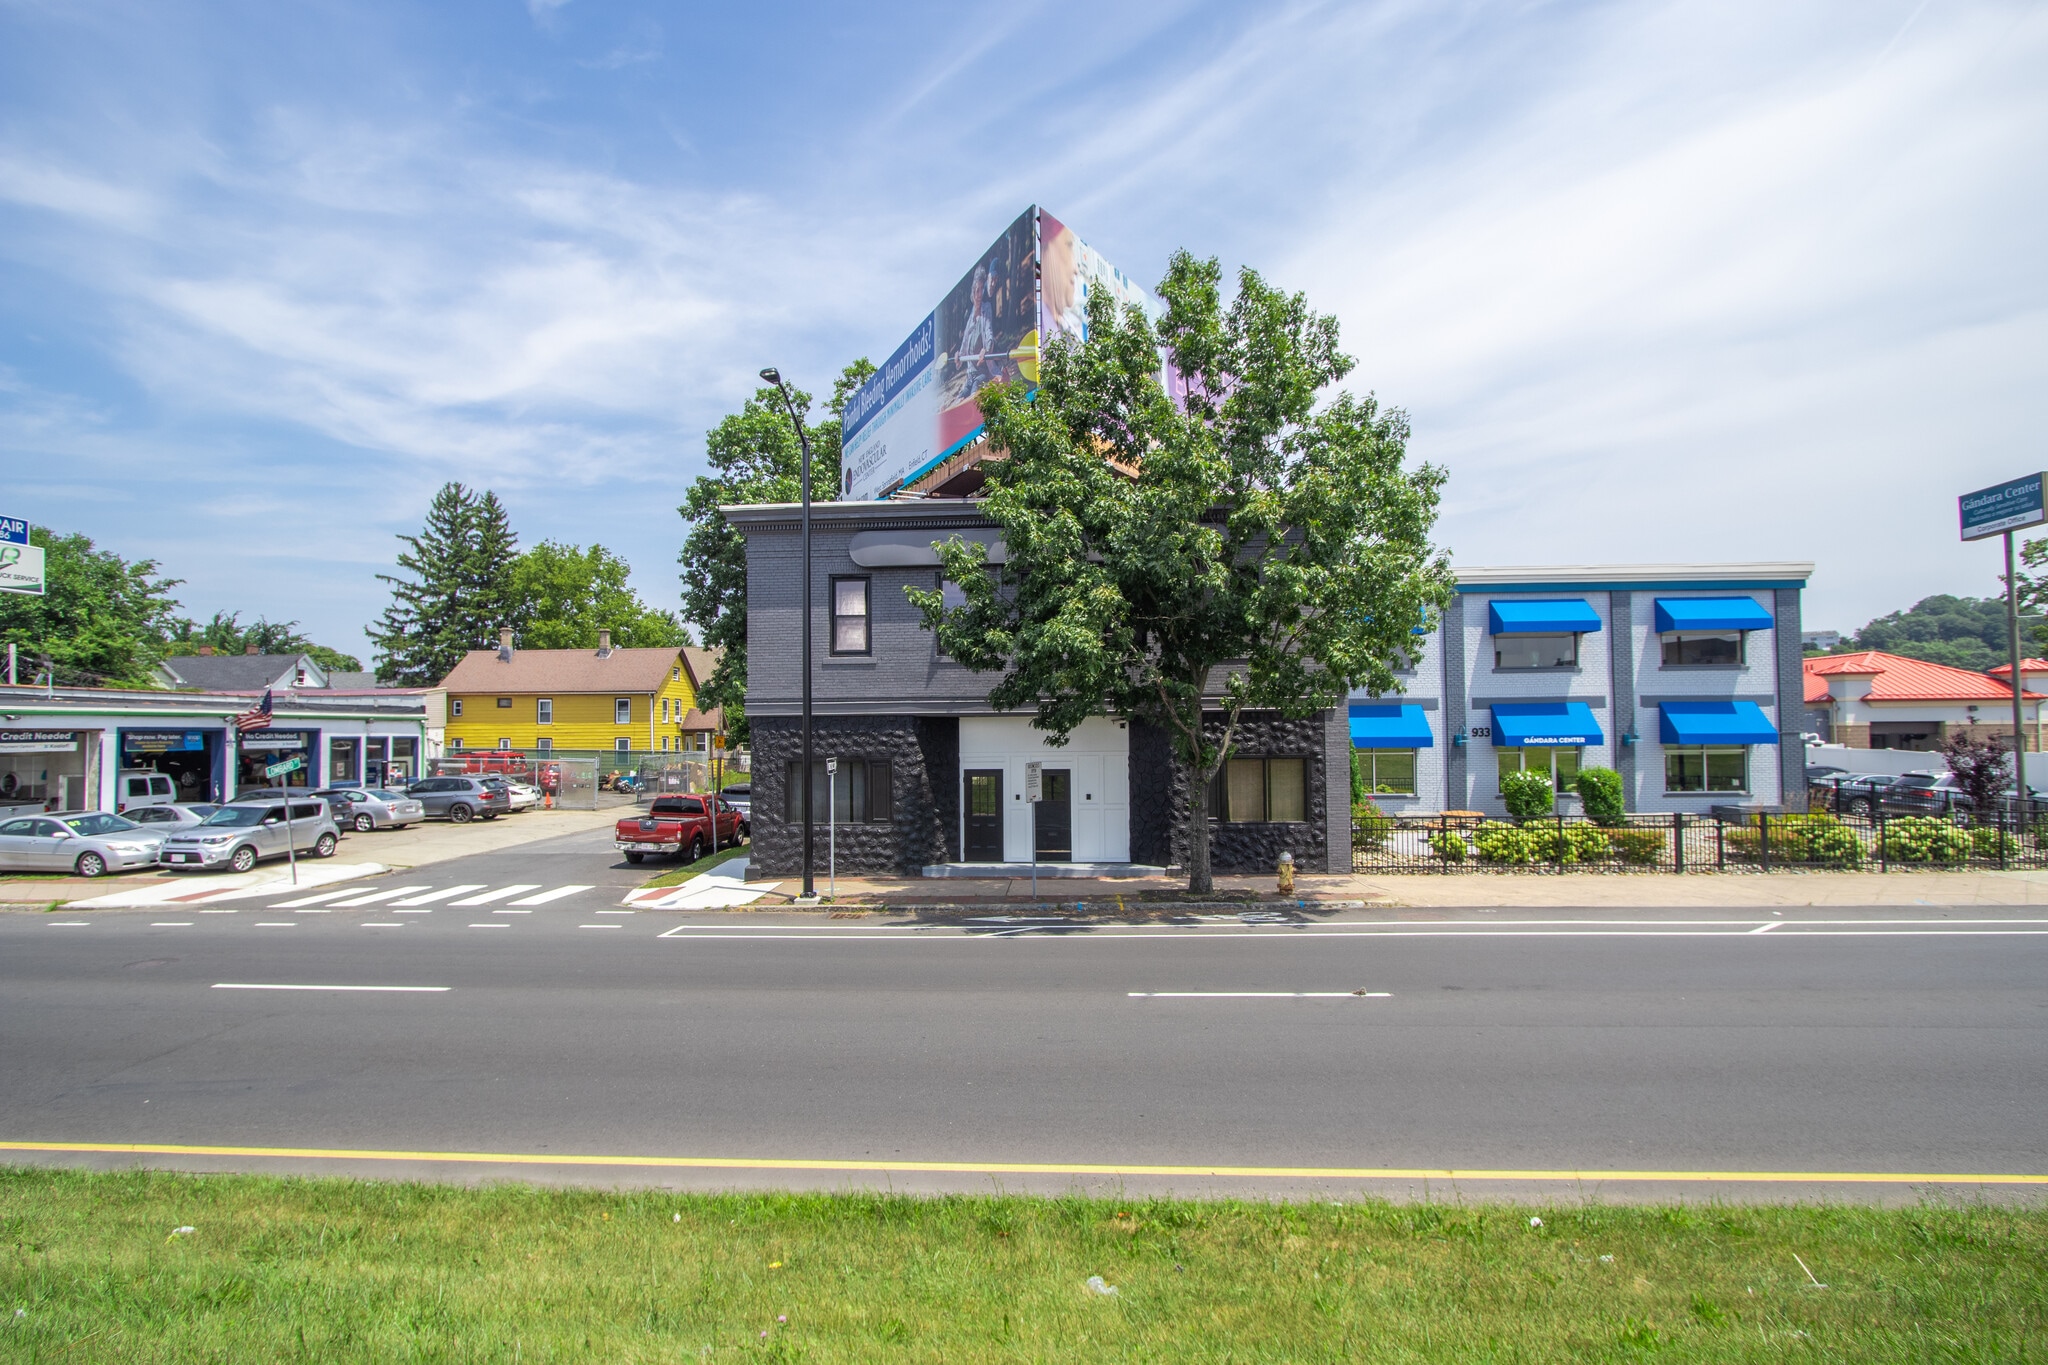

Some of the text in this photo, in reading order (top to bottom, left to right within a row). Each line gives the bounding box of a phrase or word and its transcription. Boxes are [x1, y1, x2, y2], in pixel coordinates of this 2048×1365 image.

[860, 376, 885, 415] Bleeding
[885, 319, 932, 392] Hemorrhoids?
[921, 449, 928, 461] CT
[1961, 481, 2041, 511] Gándara Center
[0, 519, 25, 534] AIR
[13, 574, 40, 583] SERVICE
[1, 732, 33, 740] Credit
[1472, 727, 1491, 737] 933
[1524, 736, 1558, 744] GÁNDARA
